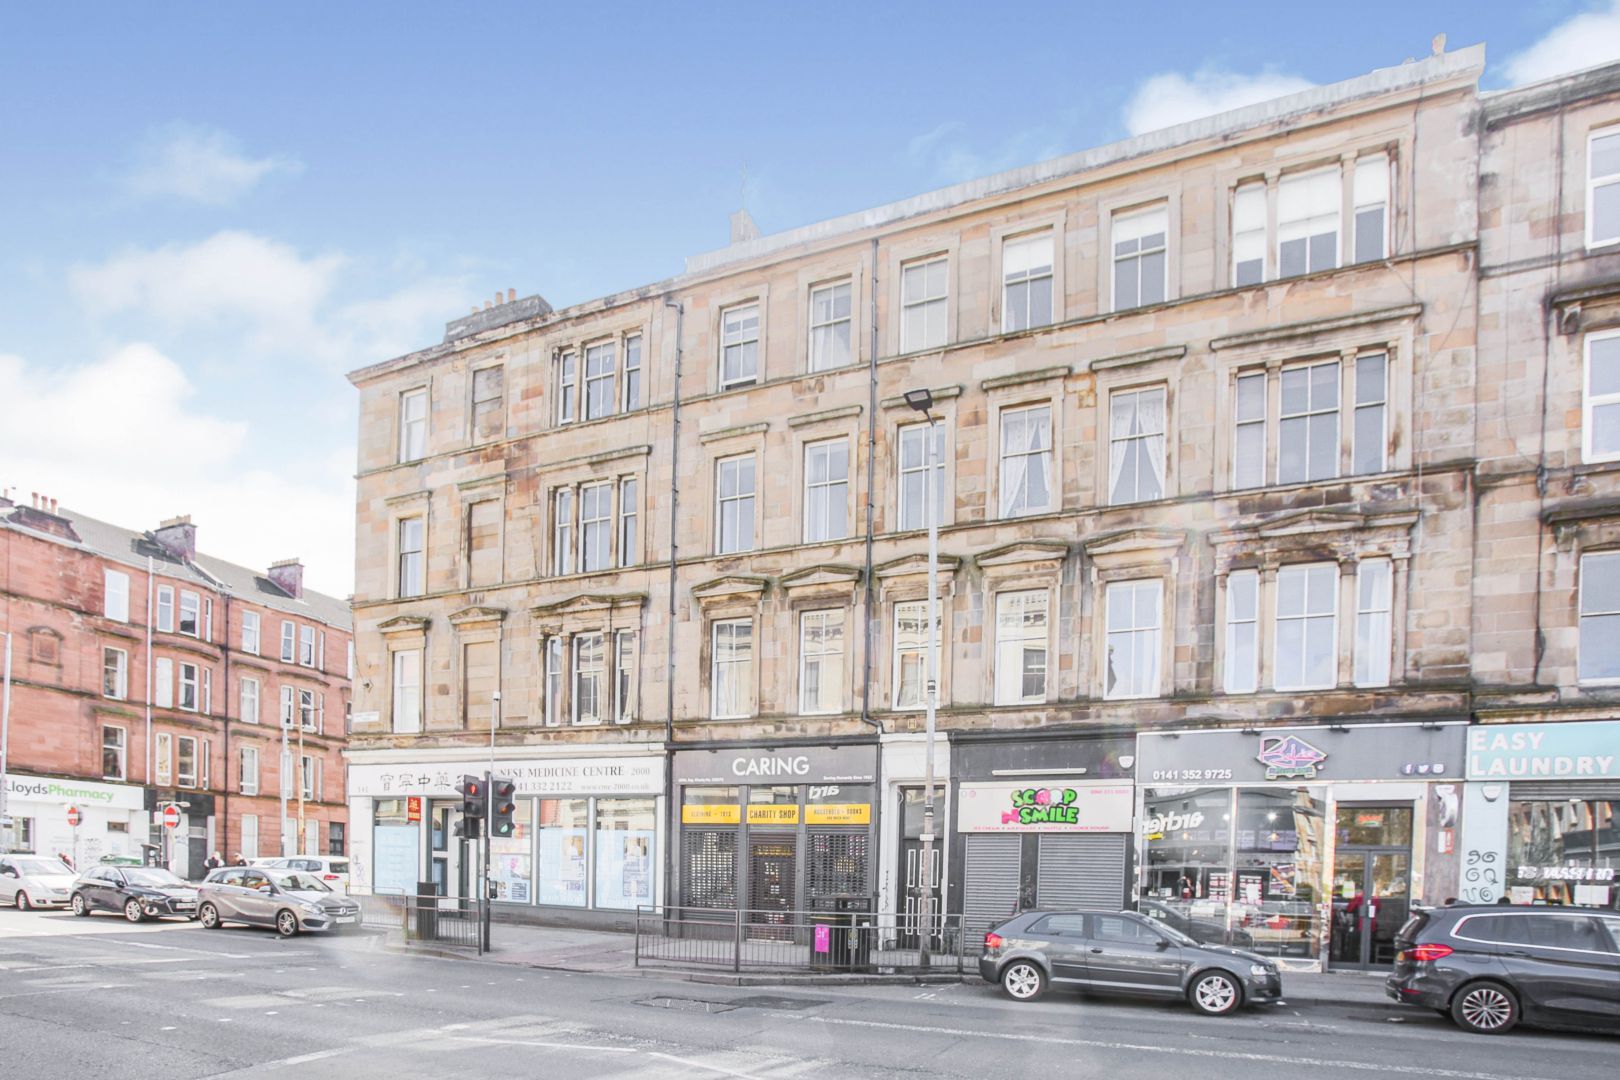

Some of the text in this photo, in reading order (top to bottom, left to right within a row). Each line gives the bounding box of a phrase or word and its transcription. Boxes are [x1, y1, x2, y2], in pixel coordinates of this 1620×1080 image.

[1470, 730, 1545, 751] EASY
[528, 766, 578, 777] MEDICINE
[583, 765, 625, 777] CENTRE
[732, 756, 810, 776] CARING
[1153, 769, 1232, 780] 0141 352 9725
[1470, 755, 1614, 775] LAUNDRY
[8, 781, 114, 802] loydsPharmacy
[750, 810, 796, 819] CHARITY SHOP
[1019, 806, 1079, 824] SMILE
